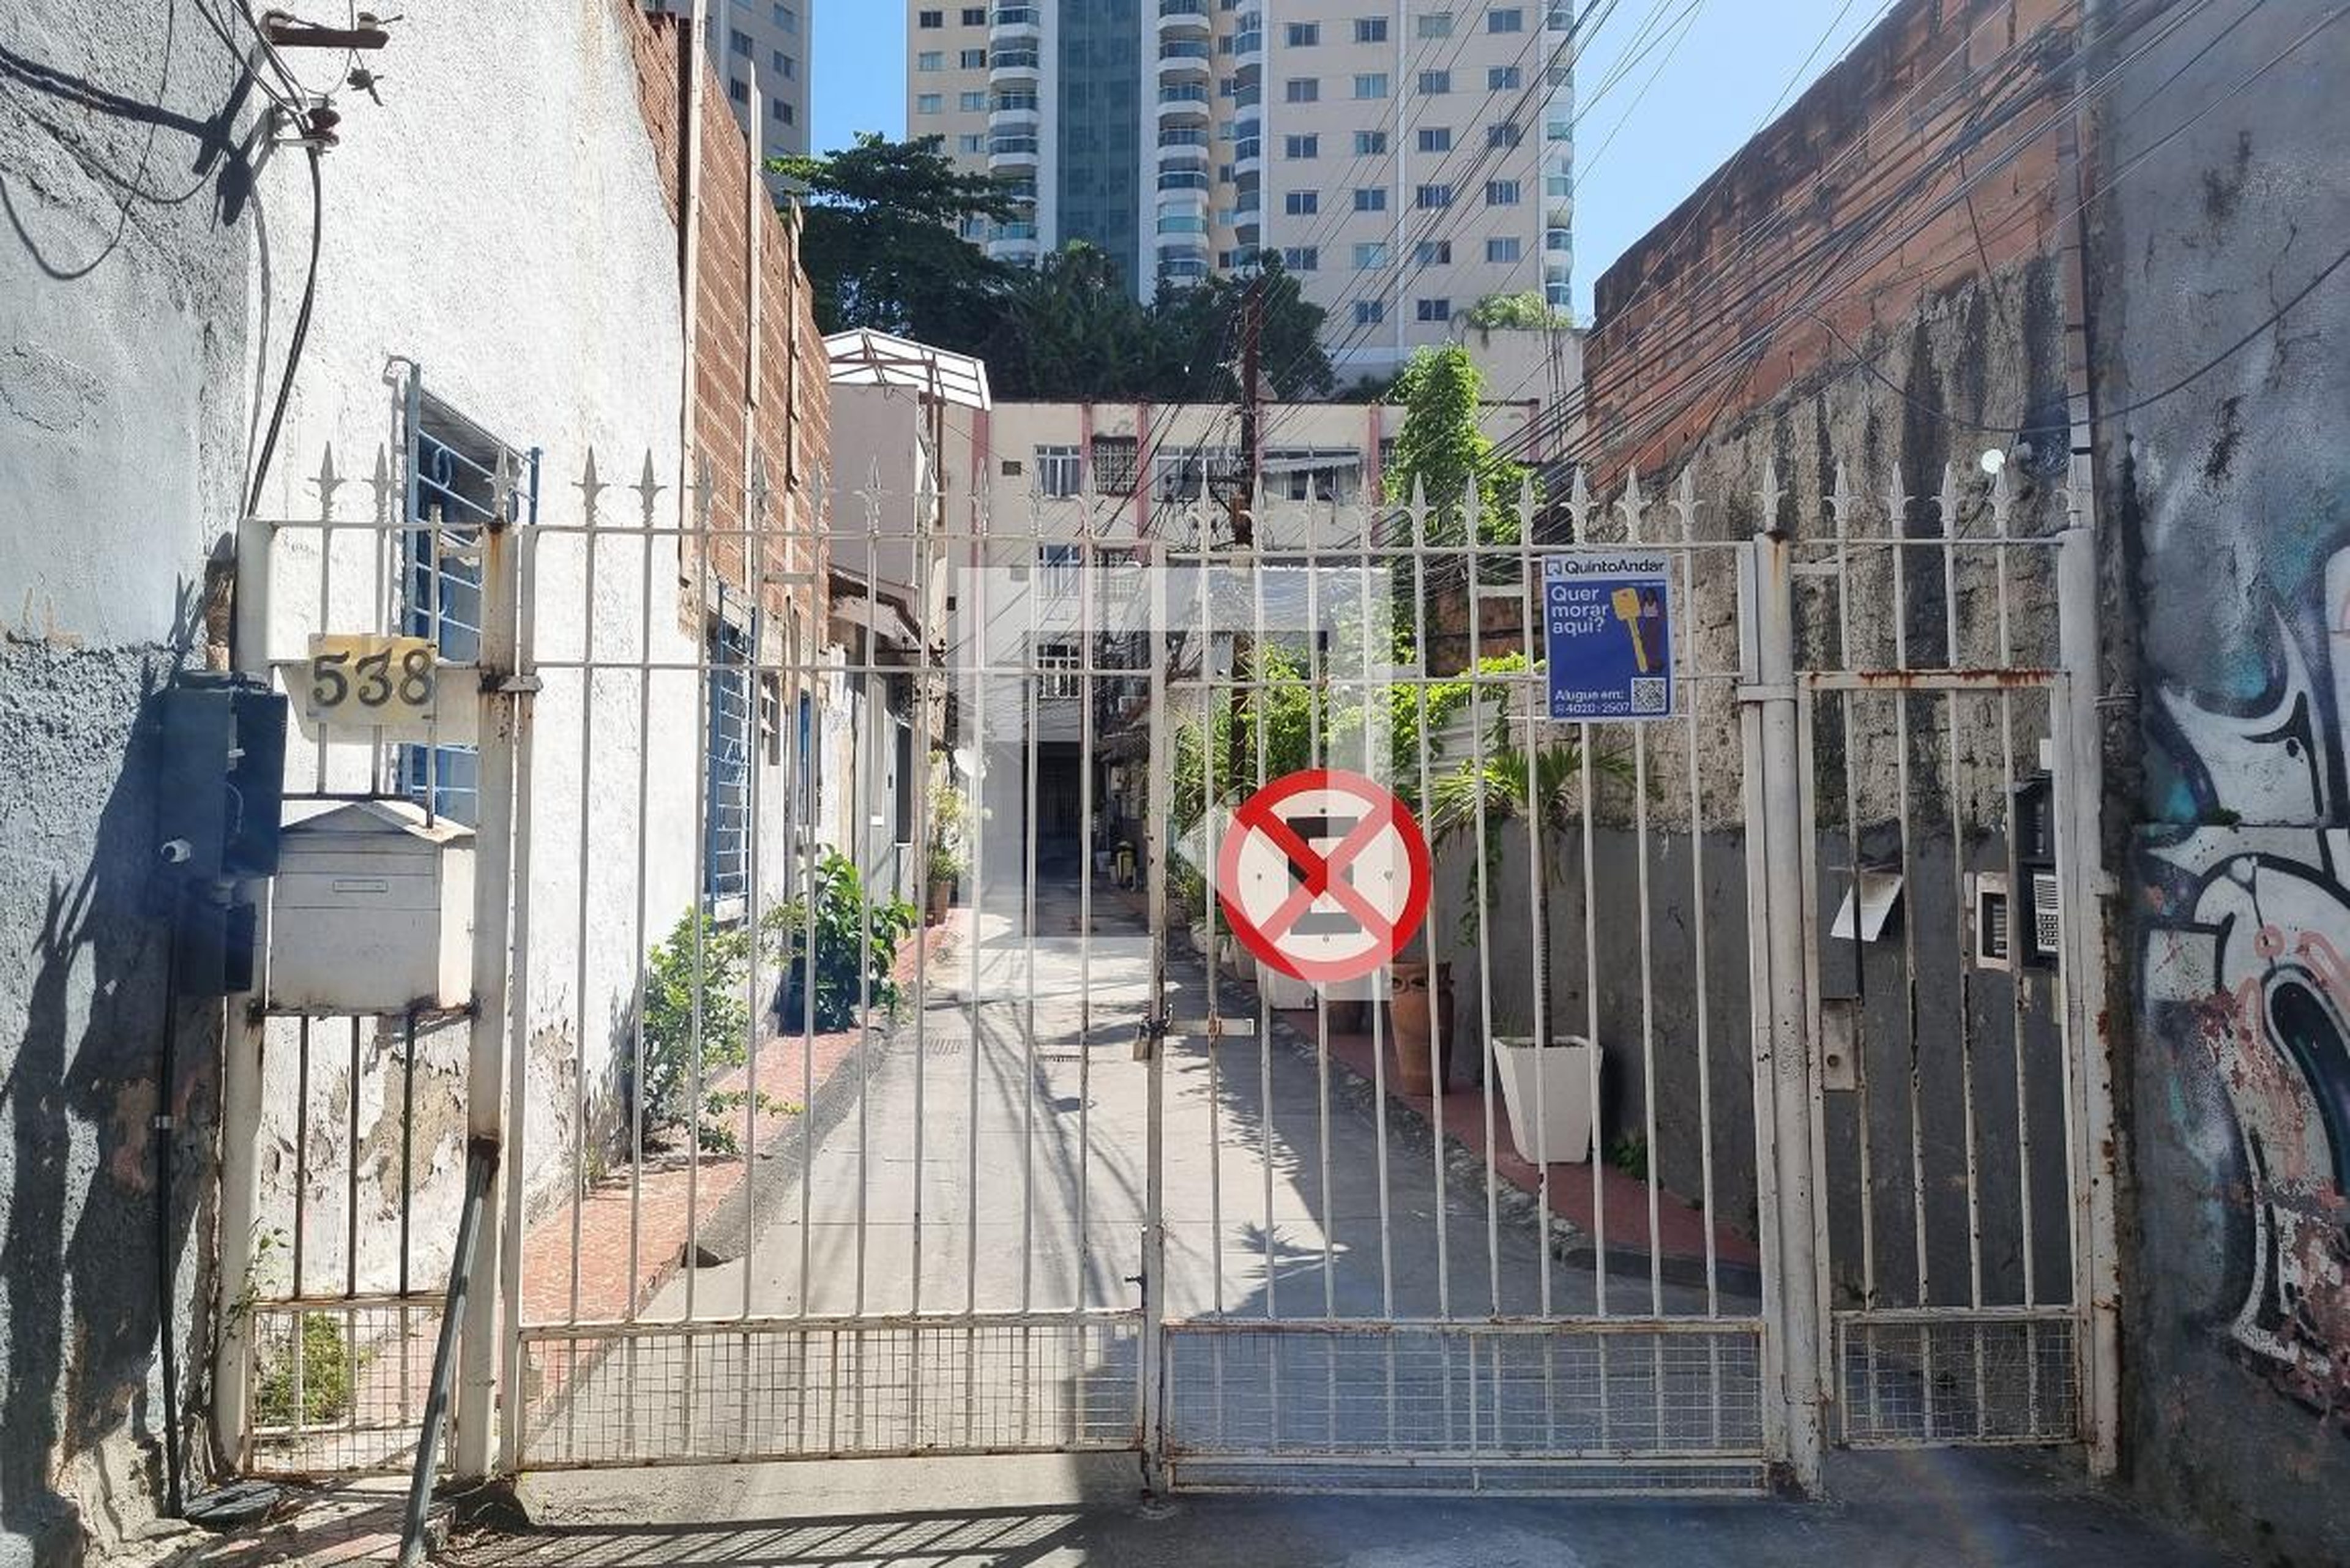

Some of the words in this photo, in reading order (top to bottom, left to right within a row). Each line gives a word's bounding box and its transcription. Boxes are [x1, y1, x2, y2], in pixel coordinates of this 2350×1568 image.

[1565, 559, 1665, 575] QuintoAndar
[1551, 586, 1599, 602] Quer
[1551, 603, 1609, 618] morar
[1553, 617, 1604, 637] aqui?
[313, 648, 434, 706] 538
[1554, 689, 1598, 703] Alugue
